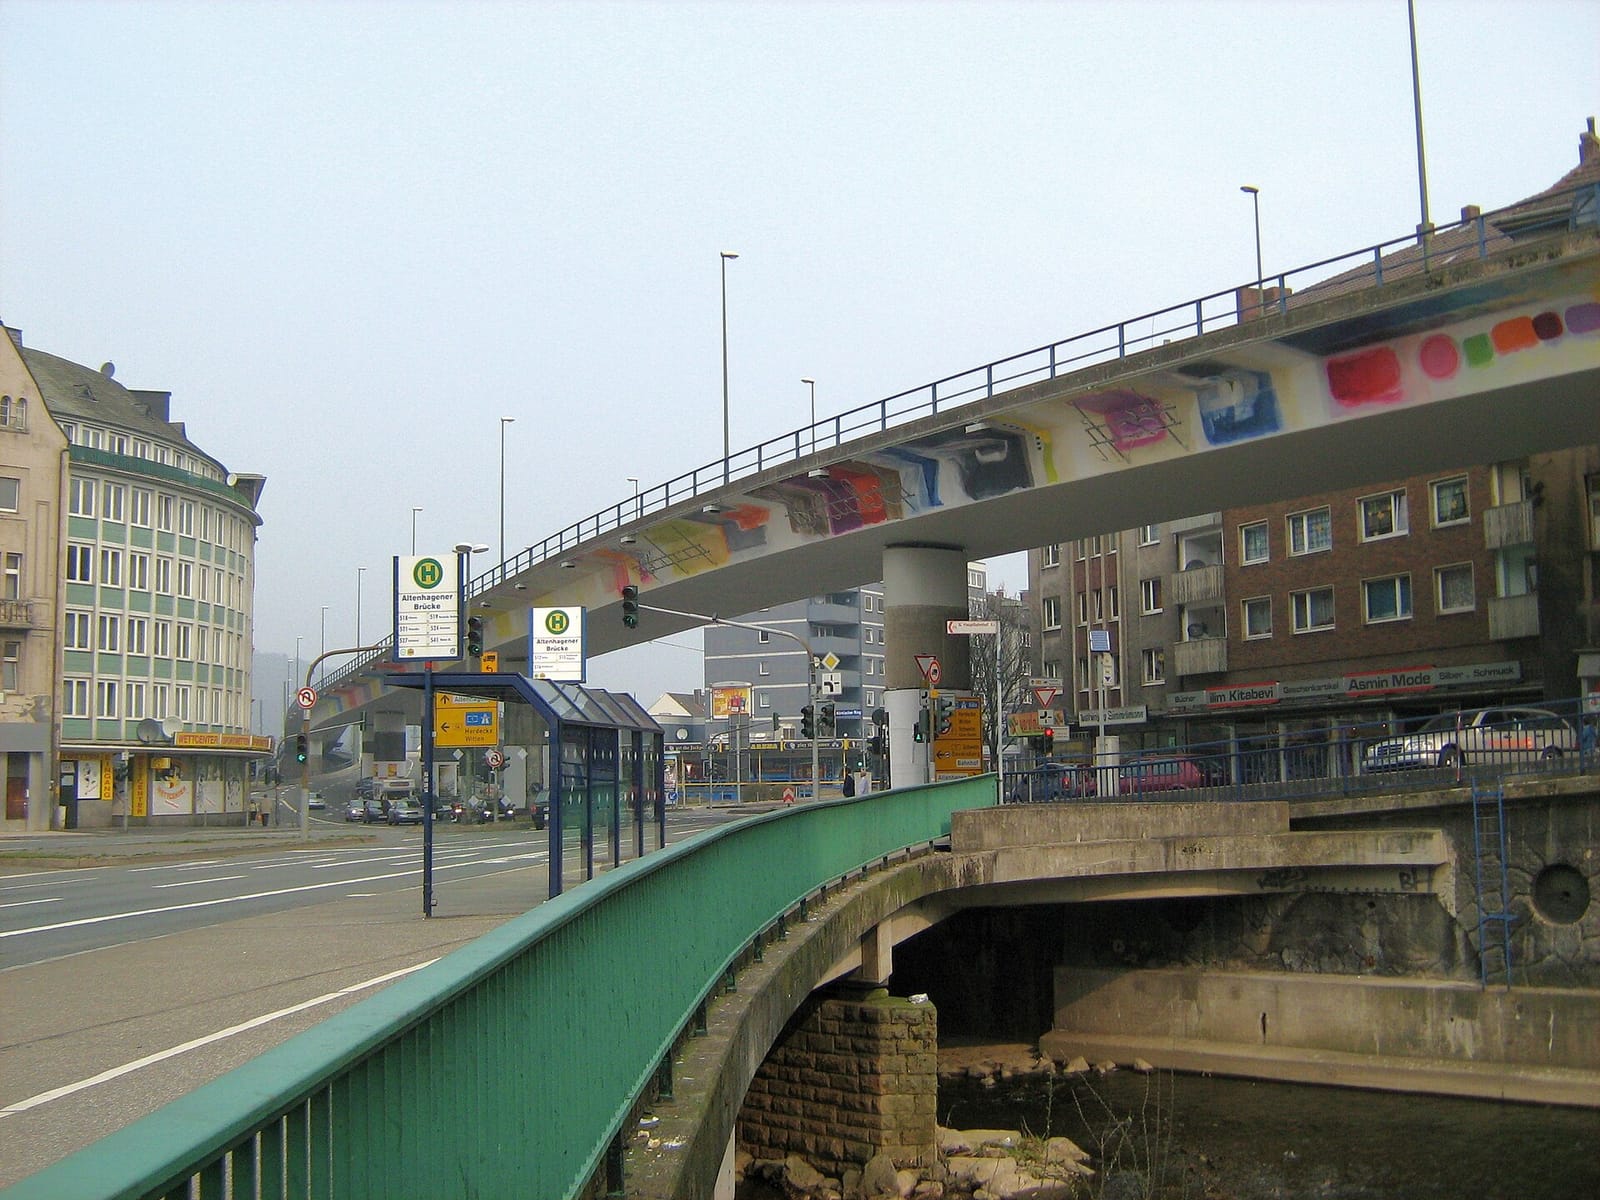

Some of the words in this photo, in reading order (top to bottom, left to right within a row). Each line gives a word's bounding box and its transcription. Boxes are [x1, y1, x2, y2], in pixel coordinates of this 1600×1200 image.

[402, 594, 453, 602] Altenhagener
[1439, 671, 1464, 680] Silber
[1474, 667, 1514, 678] Schmuck
[1349, 676, 1389, 691] Asmin
[1392, 673, 1431, 686] Mode
[1229, 687, 1274, 701] Kitabevi
[179, 733, 218, 745] WETTCENTER
